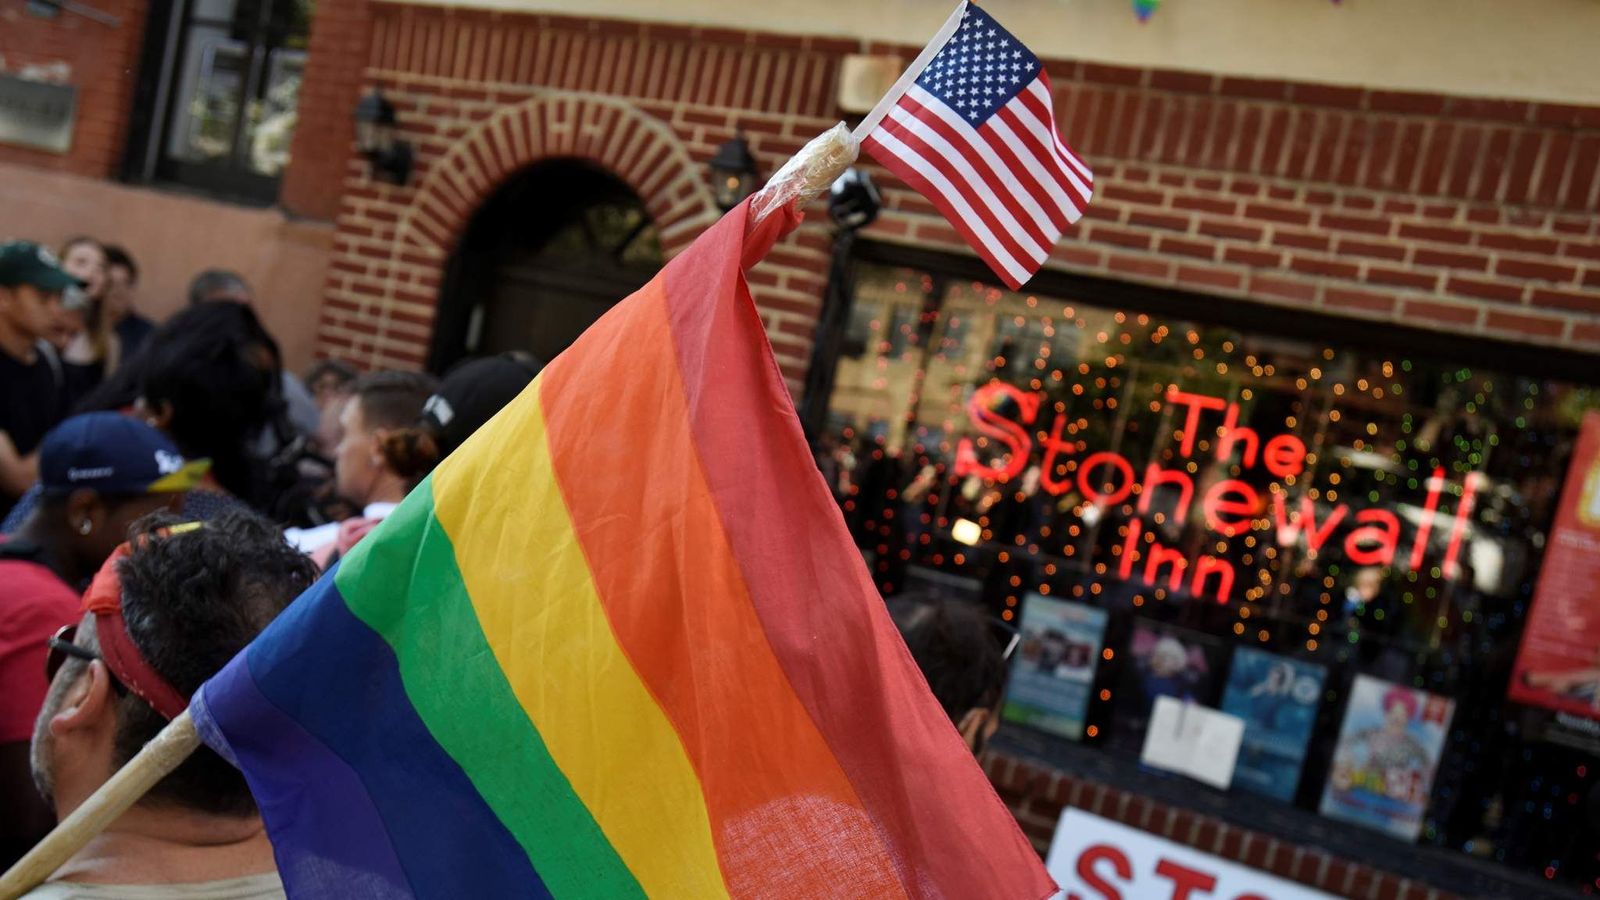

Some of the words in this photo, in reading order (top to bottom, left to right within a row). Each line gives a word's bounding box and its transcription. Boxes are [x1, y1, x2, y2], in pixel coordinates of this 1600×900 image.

[1165, 389, 1307, 478] The
[954, 381, 1477, 579] Stonewall
[1118, 518, 1235, 604] Inn
[1066, 843, 1275, 900] ST
